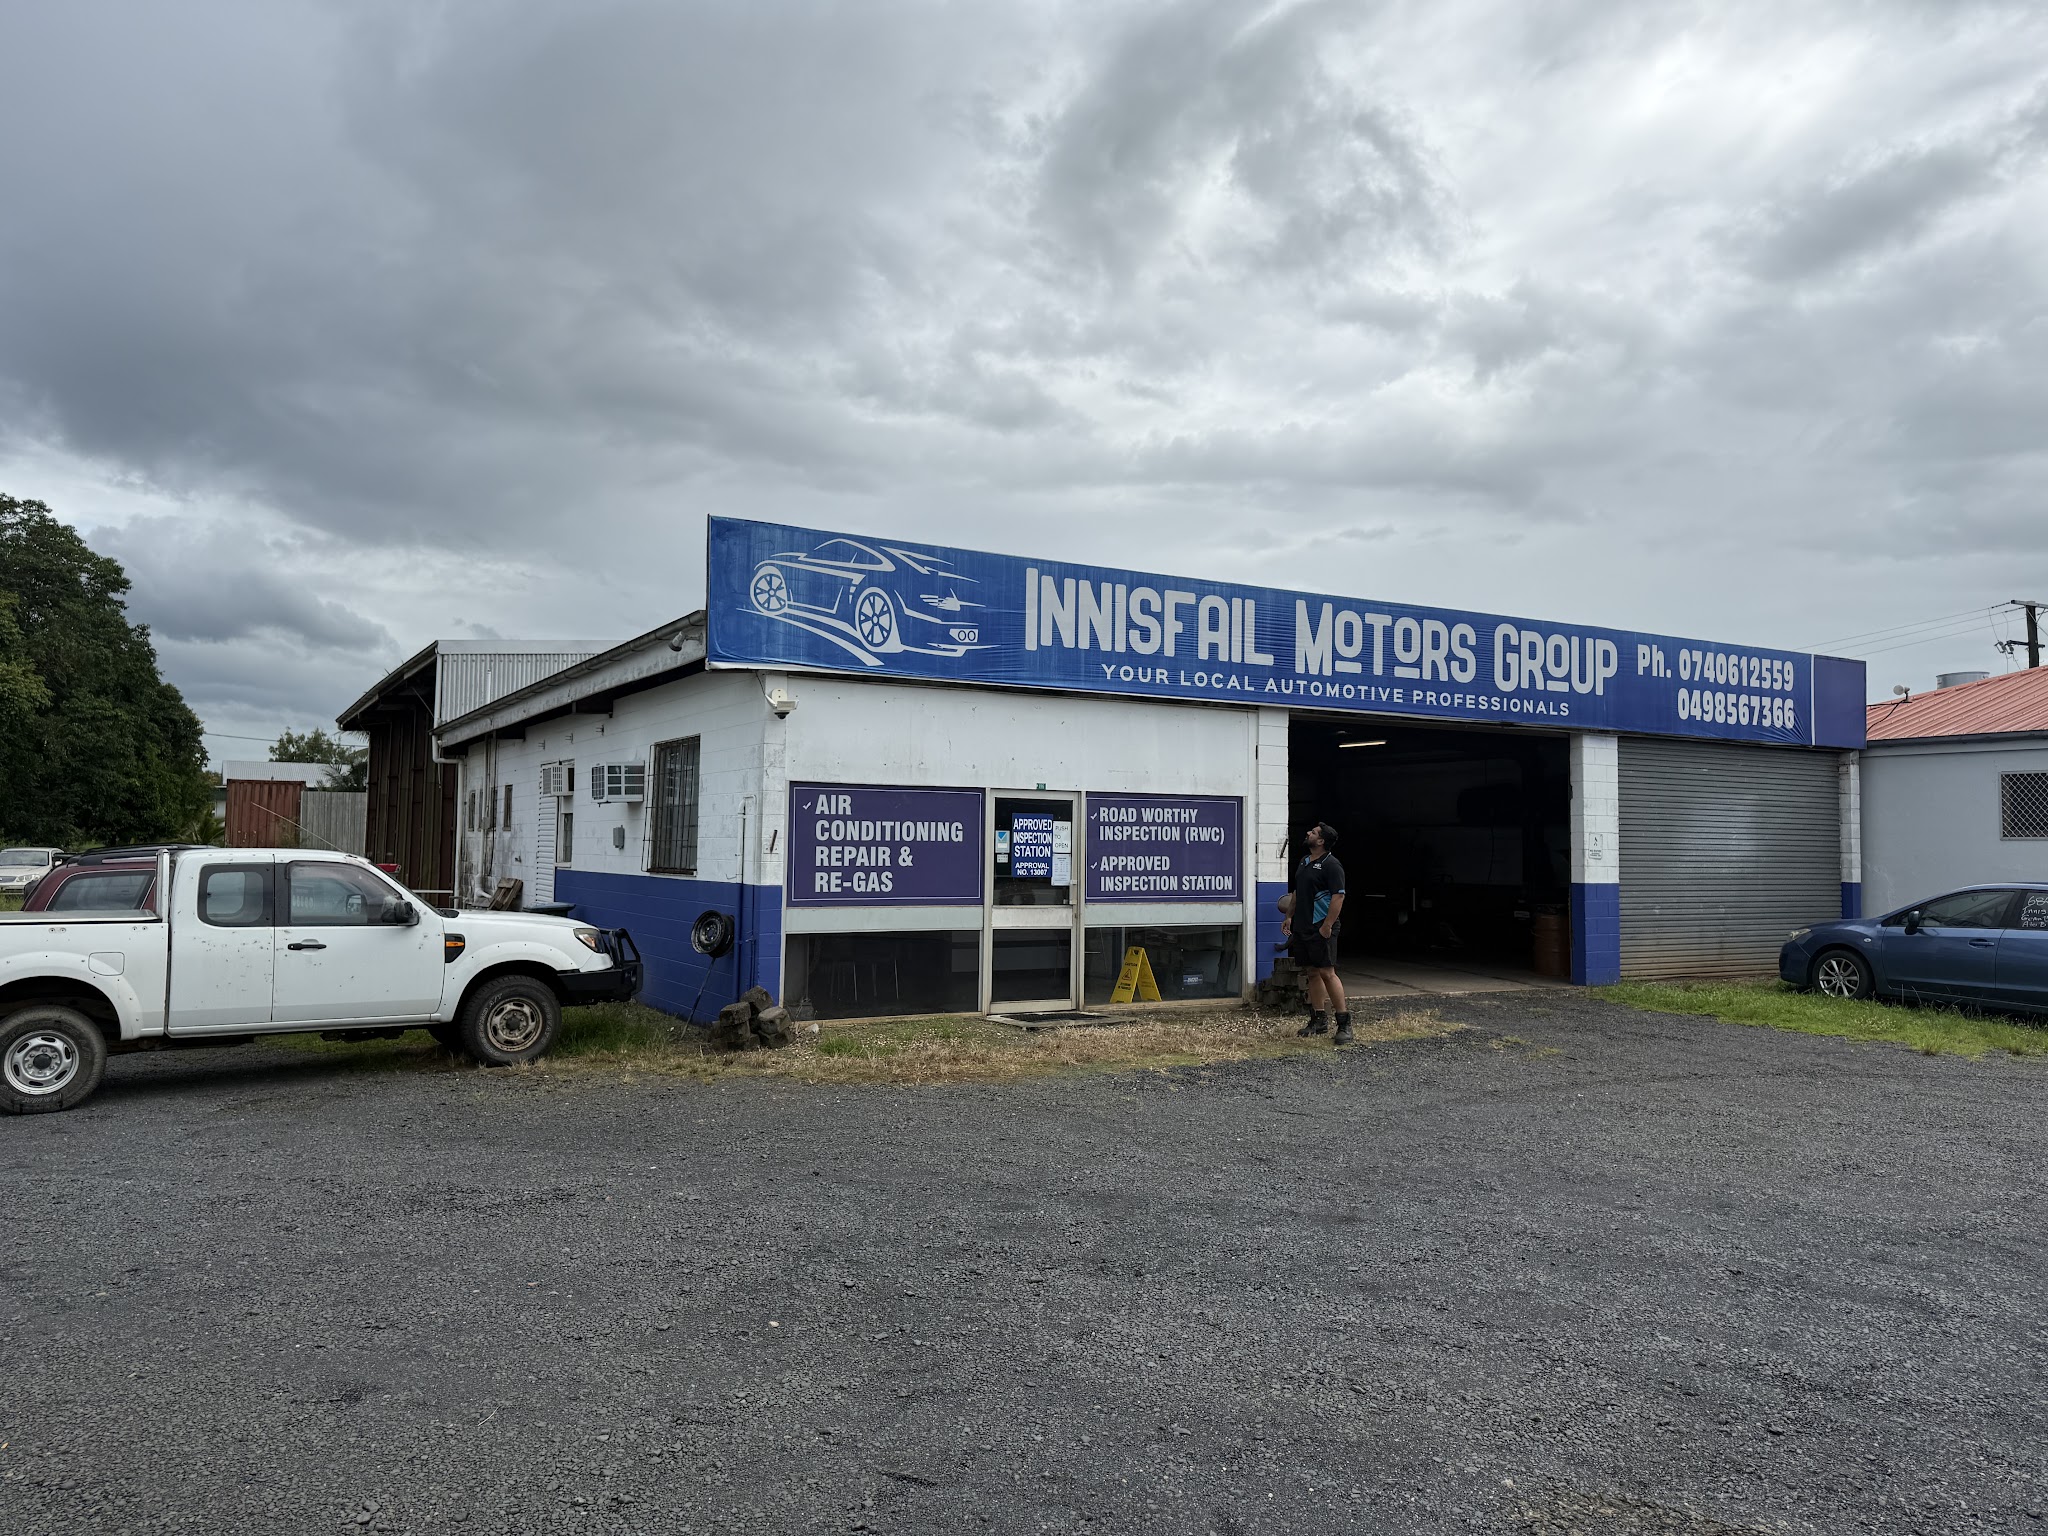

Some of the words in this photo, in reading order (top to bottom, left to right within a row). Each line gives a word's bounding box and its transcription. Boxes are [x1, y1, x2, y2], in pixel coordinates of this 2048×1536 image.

[1638, 644, 1671, 678] Ph.
[1679, 649, 1793, 691] 0740612559
[1102, 664, 1169, 684] YOUR
[1181, 671, 1254, 691] LOCAL
[1265, 678, 1403, 704] AUTOMOTIVE
[1413, 690, 1569, 717] PROFESSIONALS
[1678, 688, 1794, 729] 0498567366
[815, 795, 851, 815] AIR
[1013, 819, 1052, 830] APPROVED
[1100, 807, 1136, 822] ROAD
[1141, 808, 1198, 823] WORTHY
[816, 820, 963, 842] CONDITIONING
[1014, 832, 1052, 844] INSPECTION
[1100, 826, 1180, 841] INSPECTION
[1185, 827, 1224, 845] (RWC)
[816, 846, 891, 866] REPAIR
[899, 846, 913, 866] &
[1015, 846, 1050, 857] STATION
[1100, 856, 1169, 871] APPROVED
[815, 872, 892, 892] RE-GAS
[1101, 876, 1177, 891] INSPECTION
[1182, 876, 1232, 890] STATION
